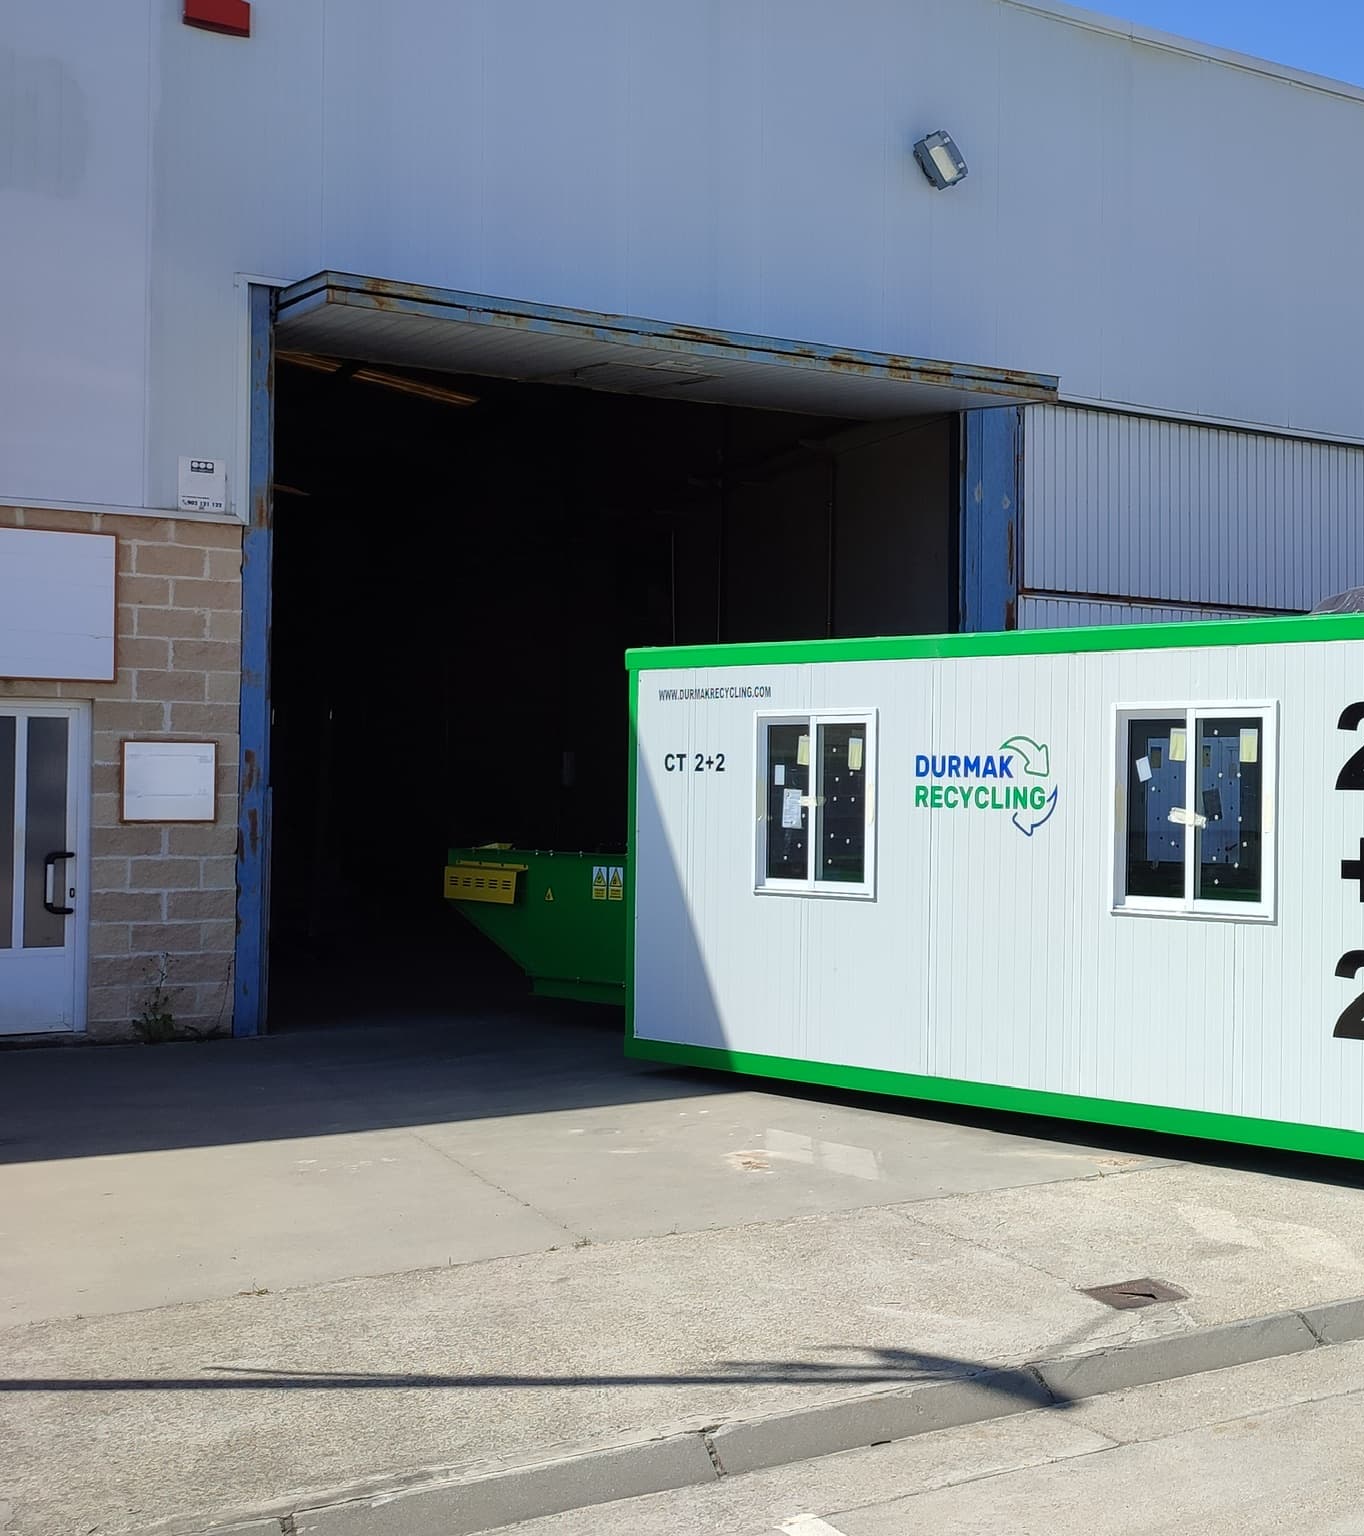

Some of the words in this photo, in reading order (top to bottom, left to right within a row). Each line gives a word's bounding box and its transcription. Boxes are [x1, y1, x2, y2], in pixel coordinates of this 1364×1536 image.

[659, 686, 771, 701] WWW.DURMAKRECYCLING.COM
[665, 753, 687, 772] CT
[694, 753, 726, 772] 2+2
[915, 755, 1014, 778] DURMAK
[915, 785, 1046, 811] RECYCLING
